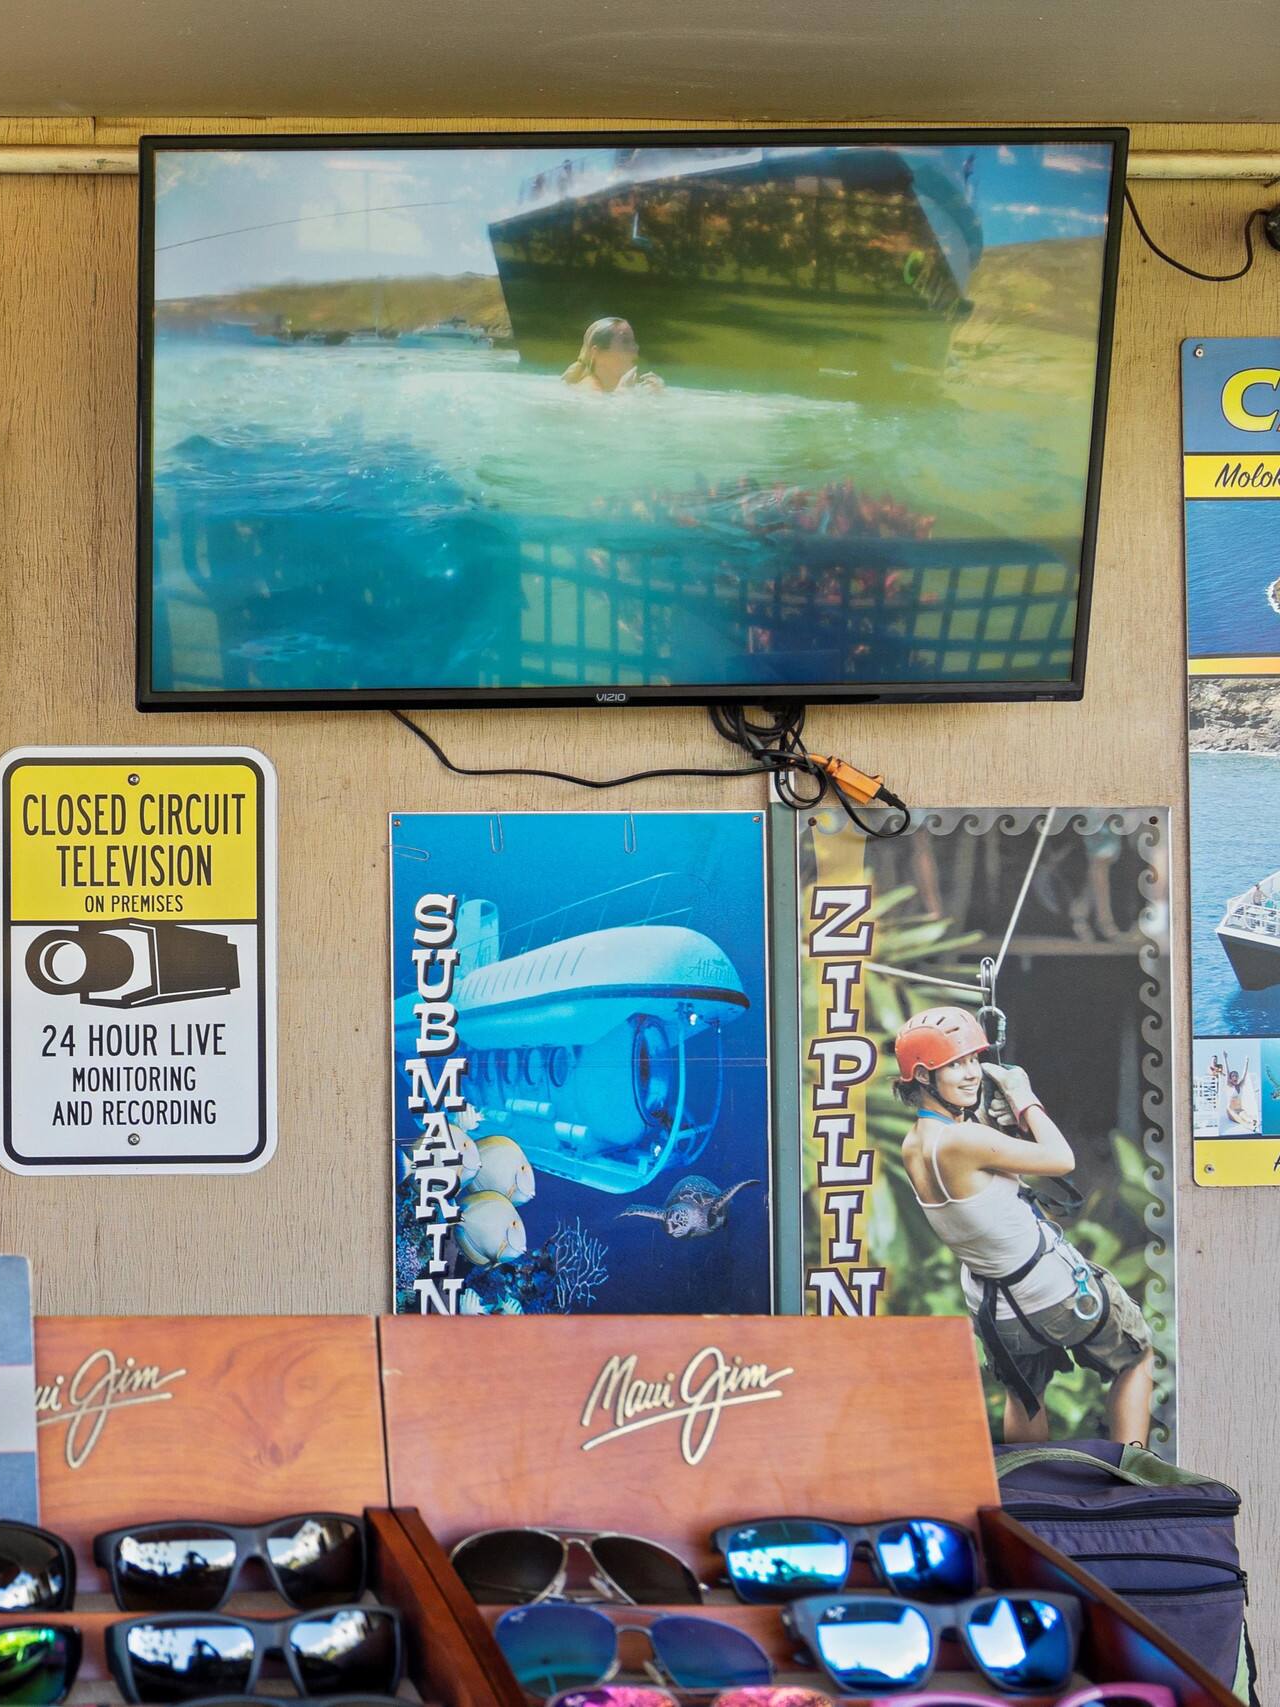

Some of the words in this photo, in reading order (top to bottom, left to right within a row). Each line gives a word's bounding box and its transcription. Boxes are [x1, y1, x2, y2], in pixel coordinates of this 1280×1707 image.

[596, 693, 626, 702] VIZIO
[23, 793, 127, 836] CLOSED
[139, 793, 246, 836] CIRCUIT
[56, 844, 212, 887] TELEVISION
[84, 895, 105, 913] ON
[111, 895, 184, 913] PREMISES
[41, 1024, 76, 1057] 24
[88, 1024, 158, 1057] HOUR
[170, 1023, 227, 1057] LIVE
[72, 1066, 197, 1092] MONITORING
[52, 1100, 93, 1126] AND
[103, 1100, 217, 1126] RECORDING
[66, 1348, 186, 1469] Jim
[581, 1354, 675, 1427] Maui
[680, 1346, 794, 1465] Jim
